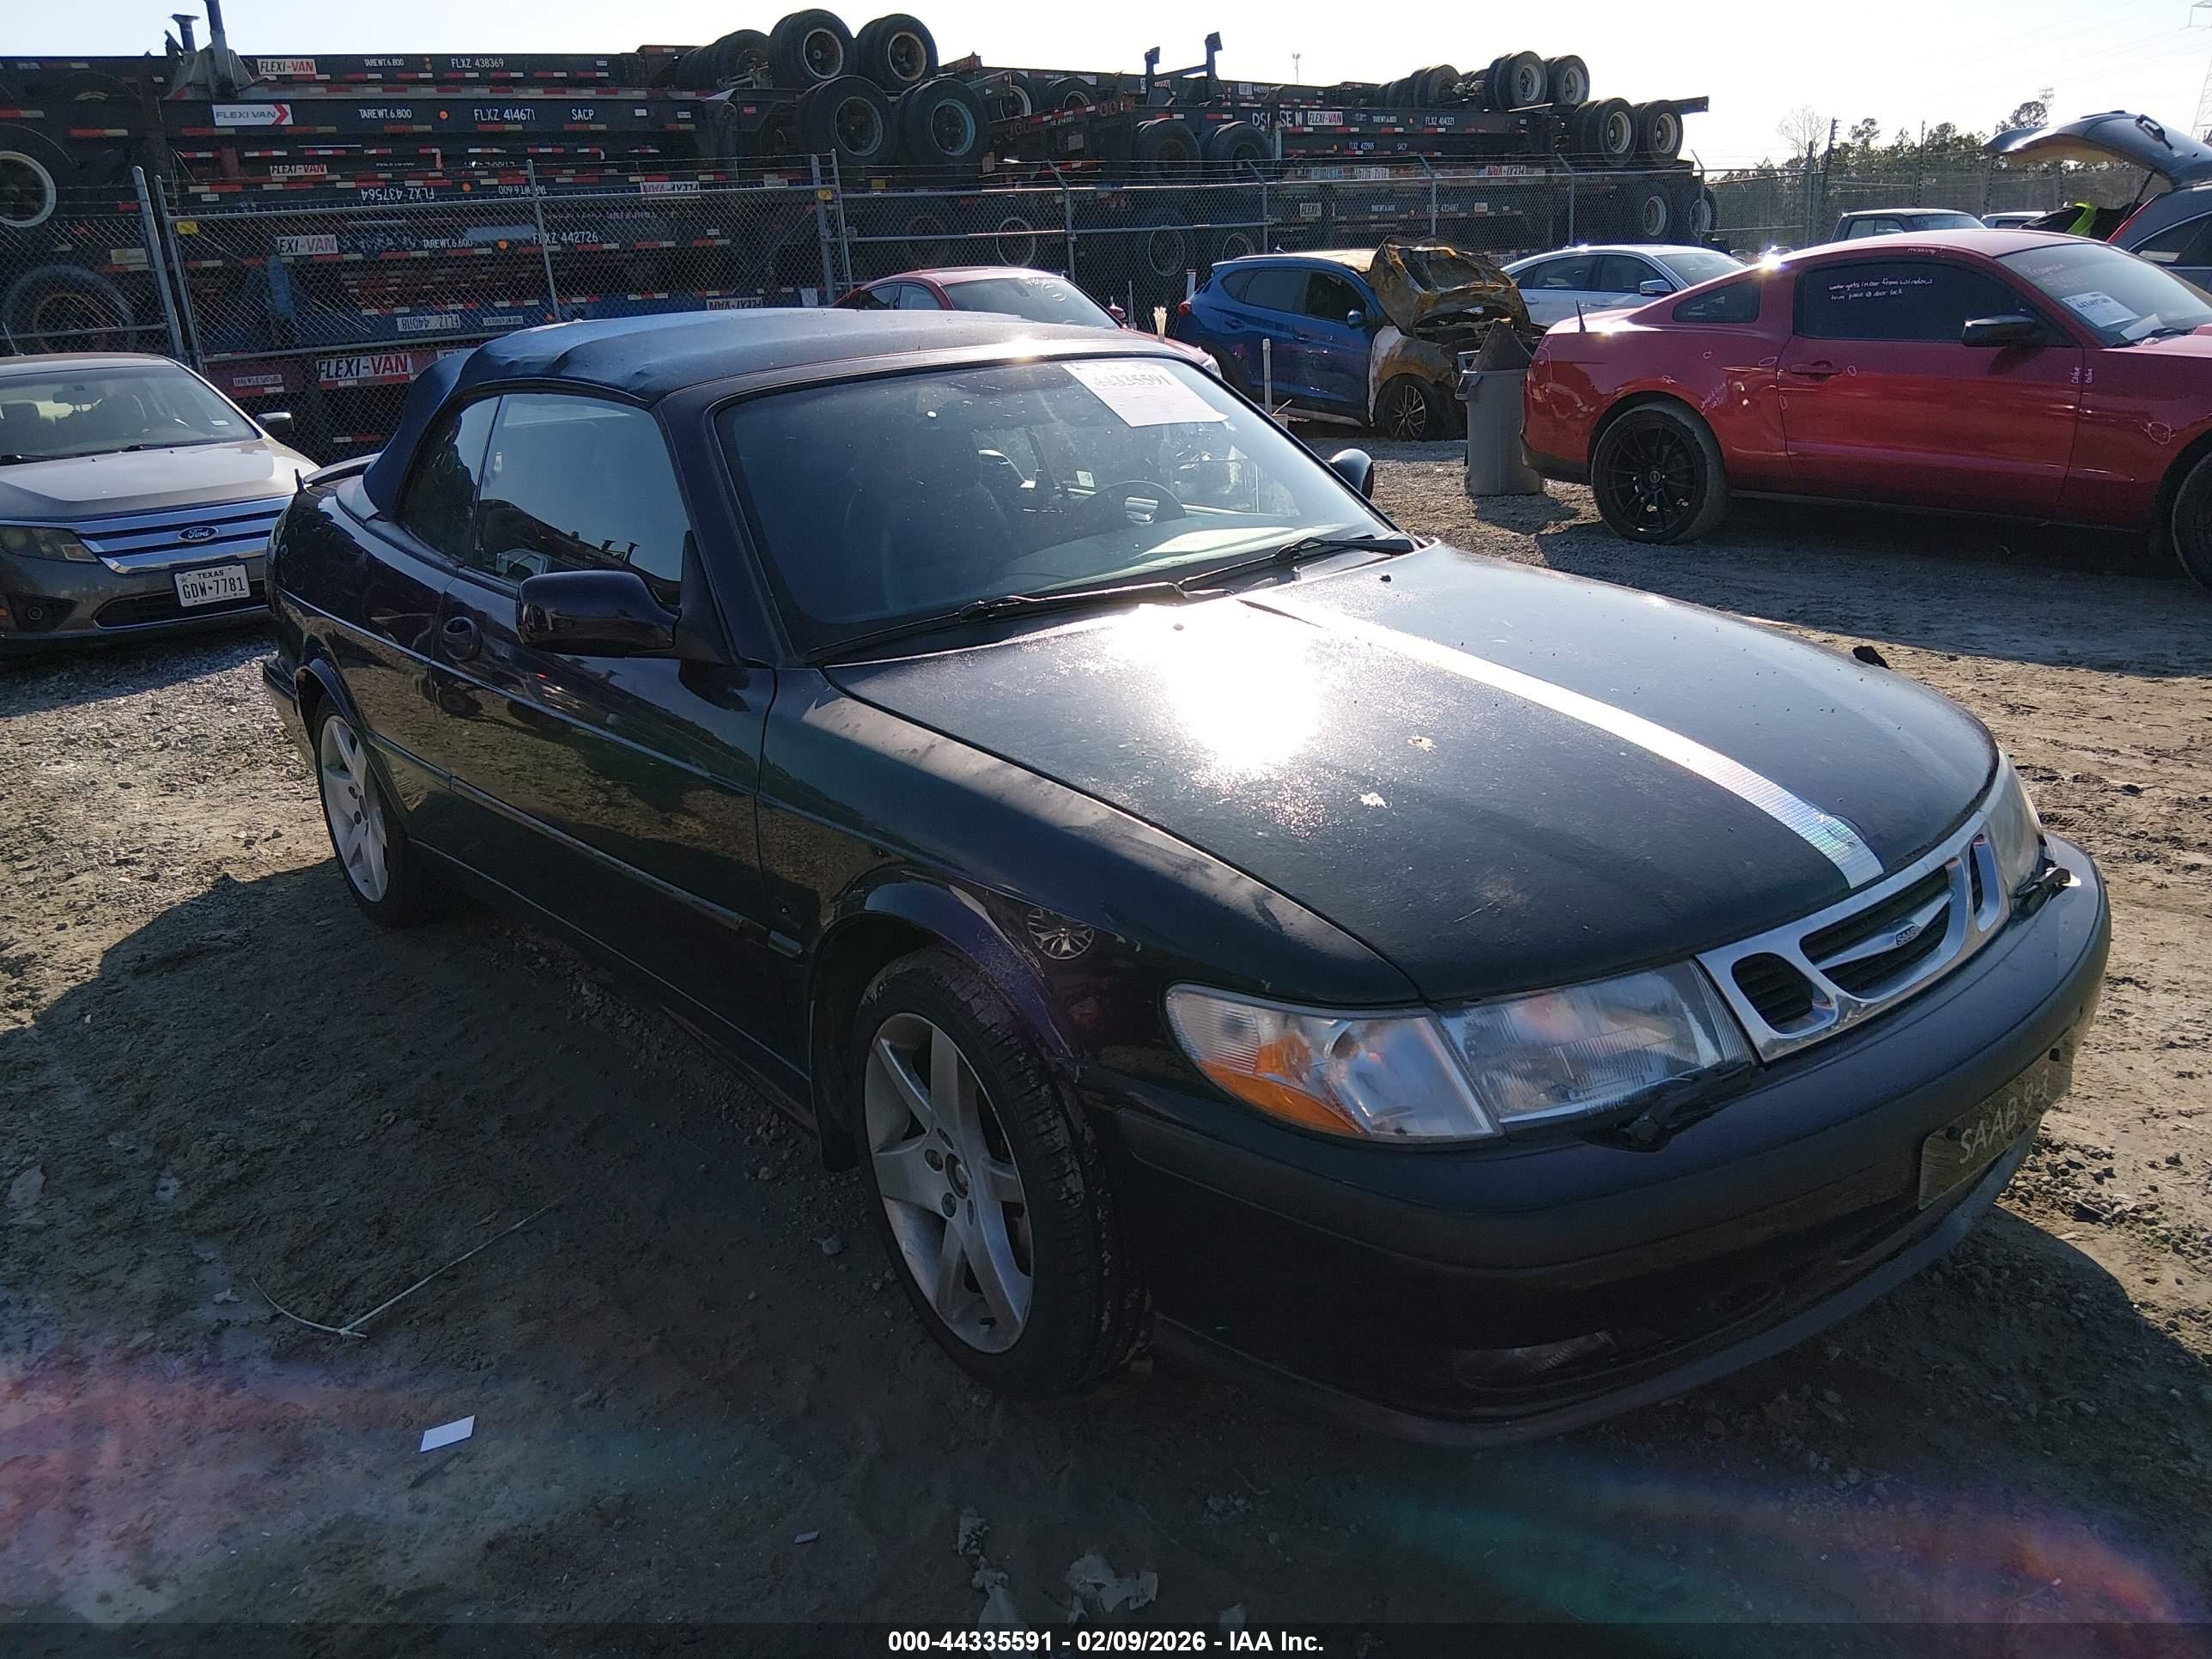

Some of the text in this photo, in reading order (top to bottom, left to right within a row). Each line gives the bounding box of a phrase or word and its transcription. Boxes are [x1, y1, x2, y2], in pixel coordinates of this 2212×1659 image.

[260, 61, 314, 73] FLEXI-VAN
[451, 58, 504, 69] FLXZ 438369
[474, 109, 536, 121] FLXZ 414671
[571, 109, 594, 120] SACP
[1309, 112, 1342, 124] FLEXI-VAN
[561, 232, 598, 244] 442726
[1882, 277, 1899, 286] from
[317, 355, 408, 379] FLEXI-VAN
[187, 528, 210, 539] Ford
[198, 569, 224, 579] TEXAS
[1960, 1096, 2018, 1164] SAAB
